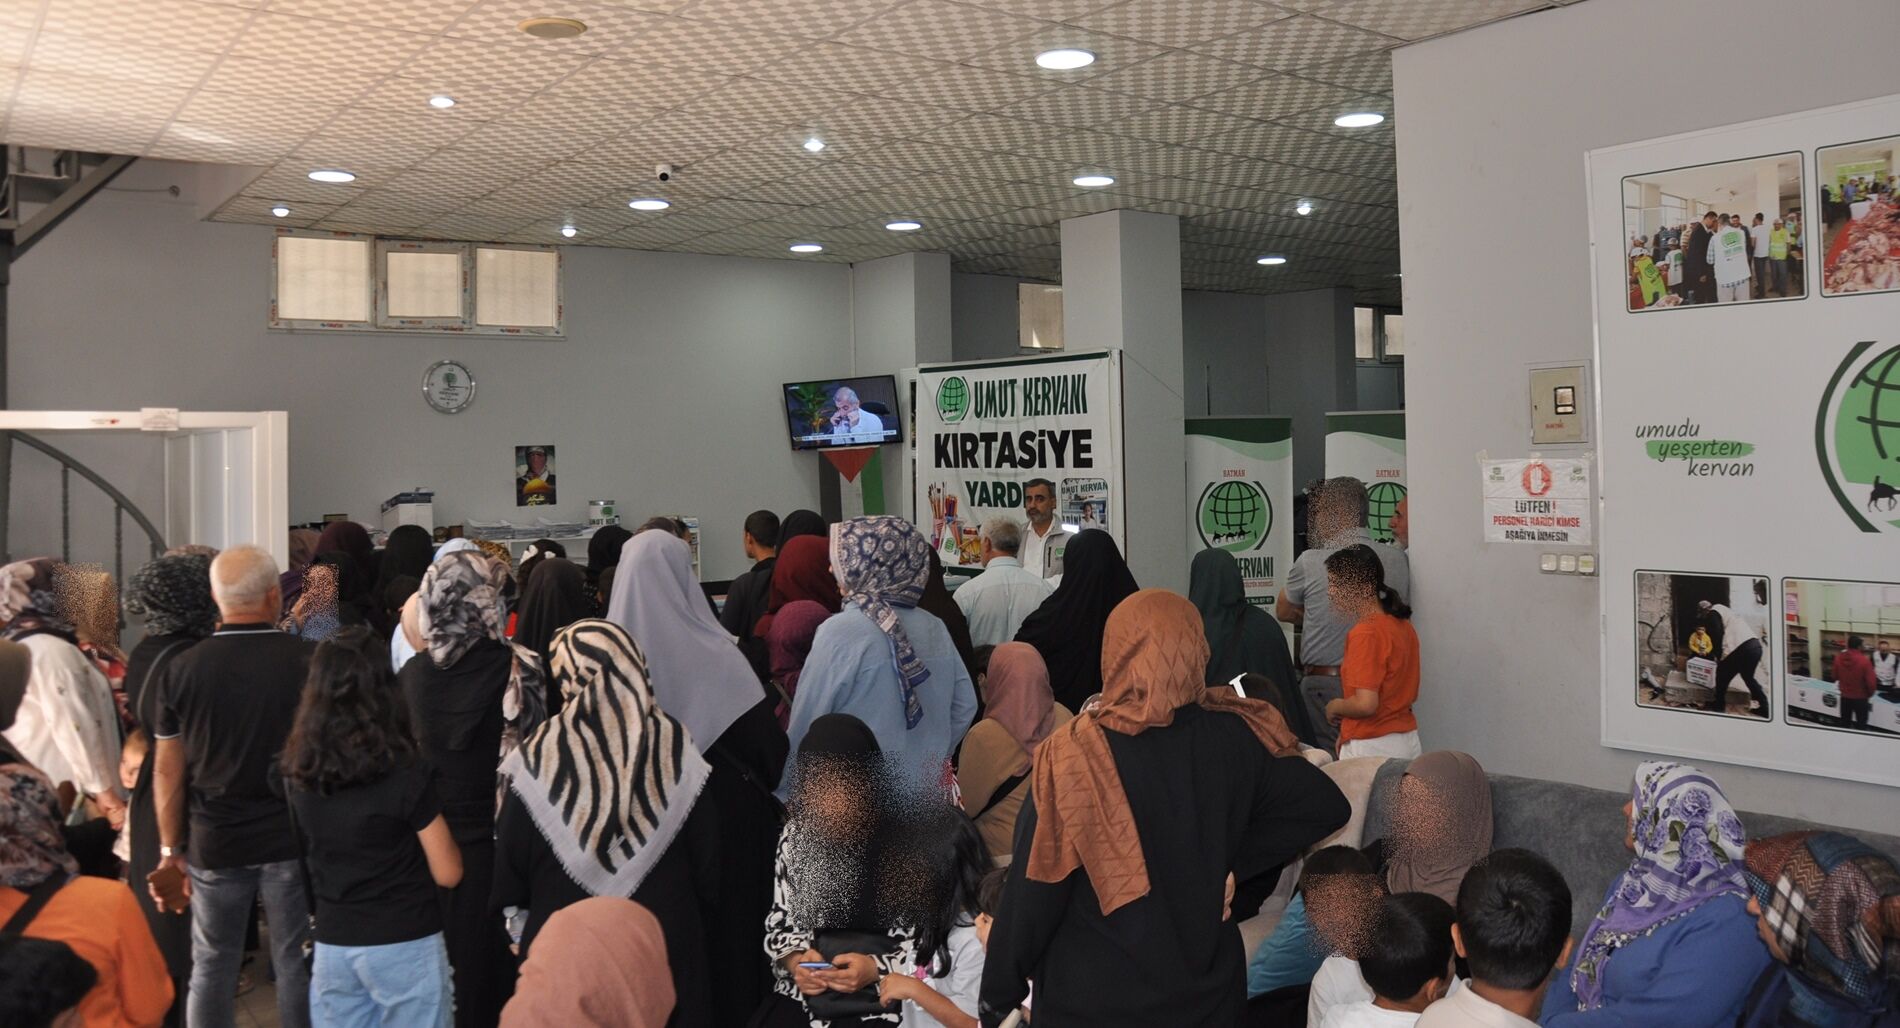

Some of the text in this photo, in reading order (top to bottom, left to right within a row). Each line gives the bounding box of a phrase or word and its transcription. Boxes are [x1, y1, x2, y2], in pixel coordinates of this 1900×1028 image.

[974, 373, 1088, 419] UMUT KERVANI
[1635, 417, 1700, 438] umudu
[1658, 439, 1743, 462] yeşerten
[1223, 469, 1246, 478] BATMAN
[1687, 456, 1754, 476] kervan
[1061, 484, 1078, 495] UMUT
[1515, 500, 1551, 513] LÜTFEN
[1493, 515, 1529, 527] PERSONEL
[1556, 516, 1581, 528] KİMSE
